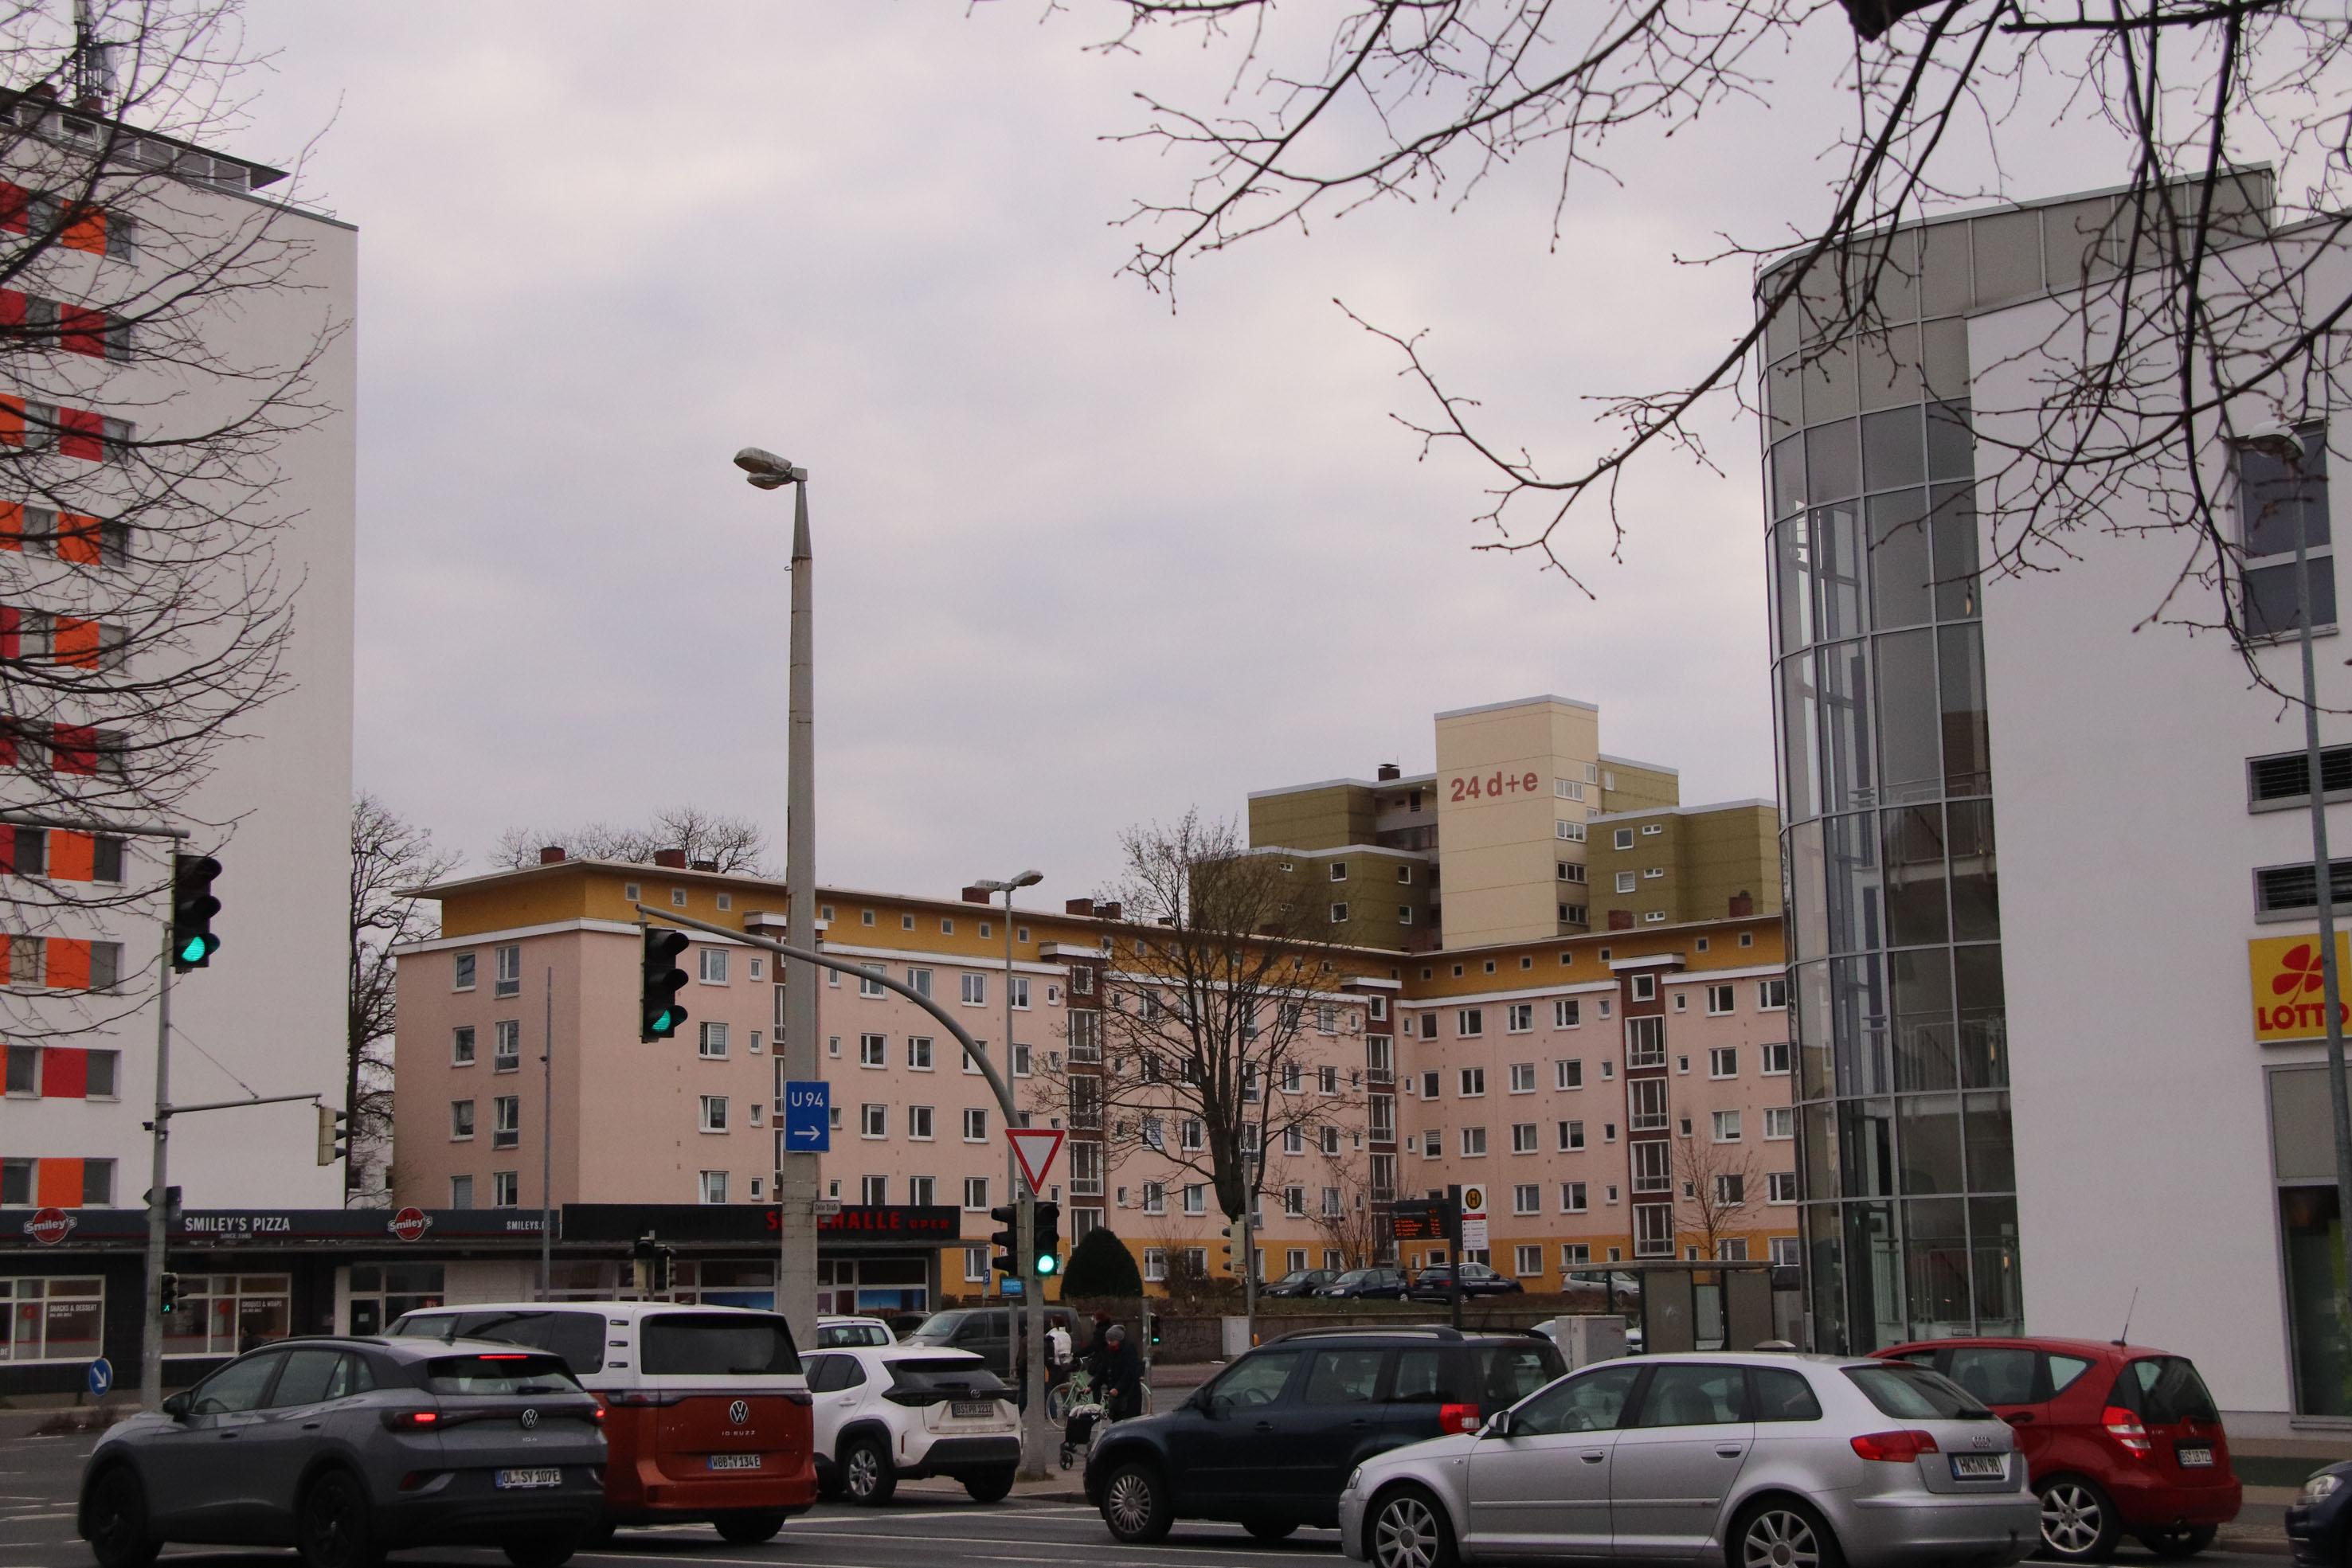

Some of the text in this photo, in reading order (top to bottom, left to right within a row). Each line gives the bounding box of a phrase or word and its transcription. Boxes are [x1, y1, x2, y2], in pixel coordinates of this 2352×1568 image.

[1450, 771, 1538, 802] 24 d+e
[791, 1092, 824, 1107] U 94
[25, 1216, 77, 1234] Smiley's
[185, 1217, 291, 1231] SMILEY'S PIZZA
[388, 1216, 432, 1232] Smiley's
[507, 1220, 550, 1230] SMILEYS.
[765, 1210, 900, 1230] SLHALLE
[1988, 1457, 2000, 1472] 98
[522, 1471, 534, 1483] SY
